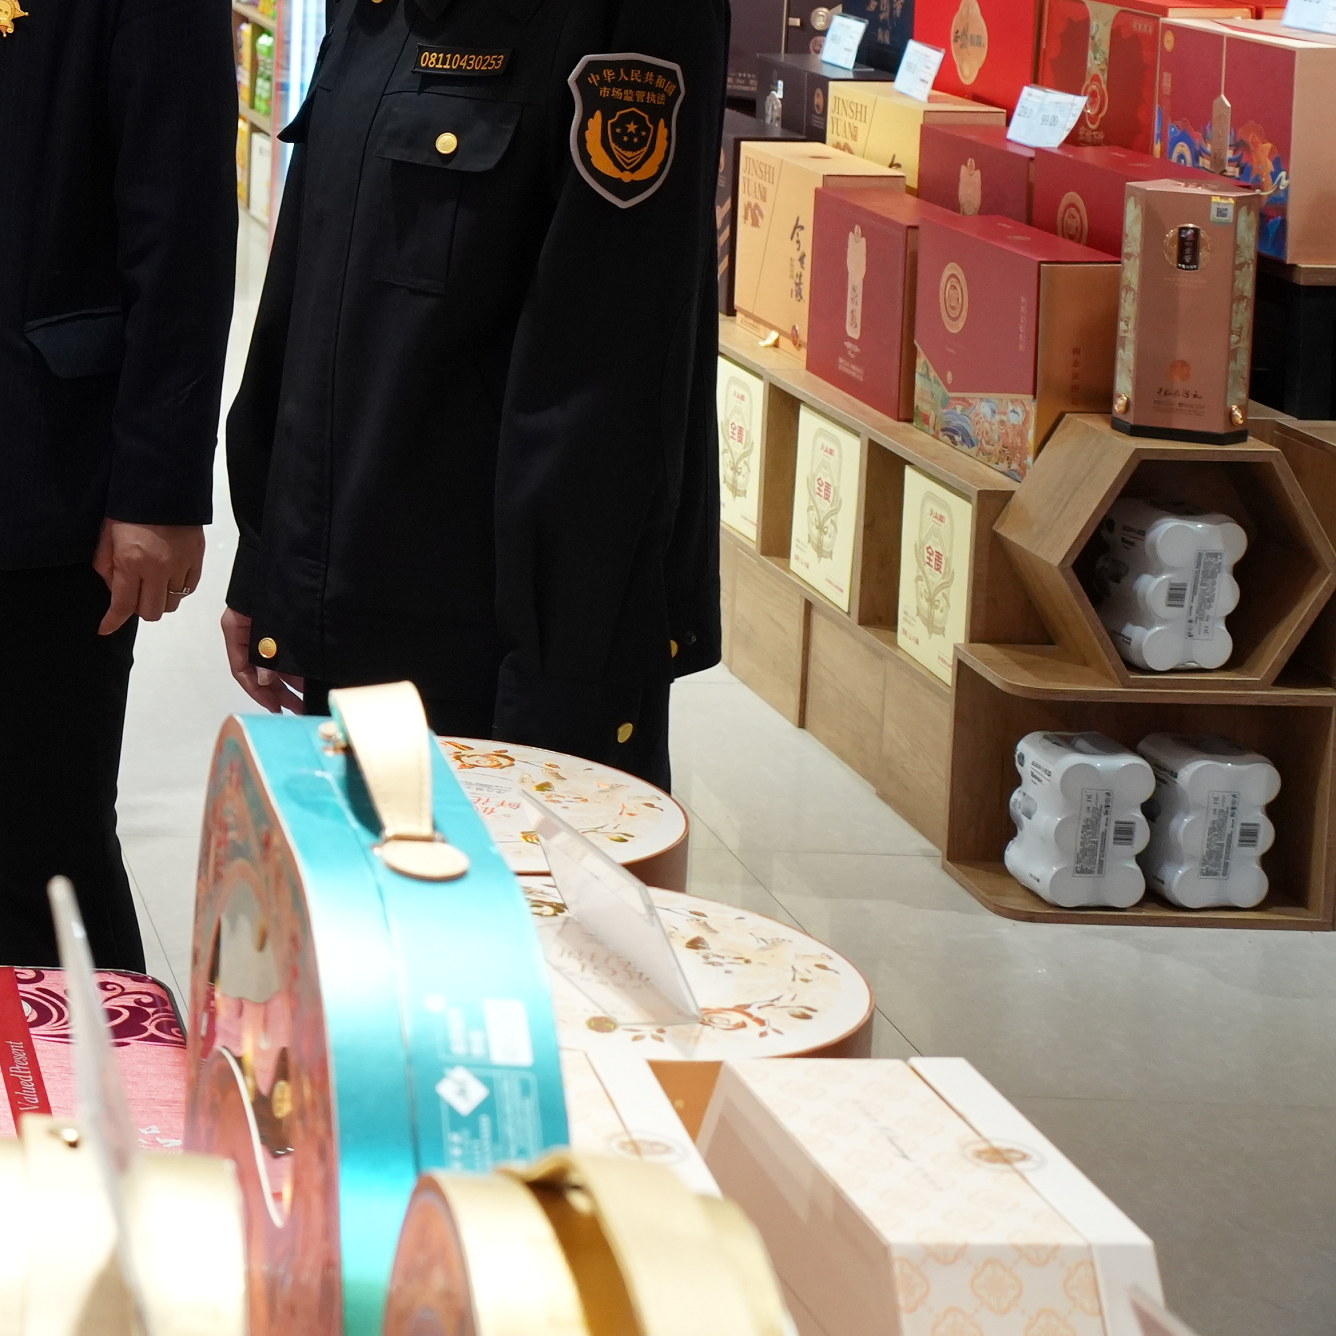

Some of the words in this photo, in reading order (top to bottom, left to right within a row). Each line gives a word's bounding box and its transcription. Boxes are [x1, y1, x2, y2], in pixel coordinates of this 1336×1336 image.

[420, 51, 505, 70] 08110430253
[587, 67, 677, 97] 中华人民共和国
[599, 86, 666, 105] 市场监管执法
[830, 94, 869, 123] JINSHI
[741, 153, 776, 187] JINSHI
